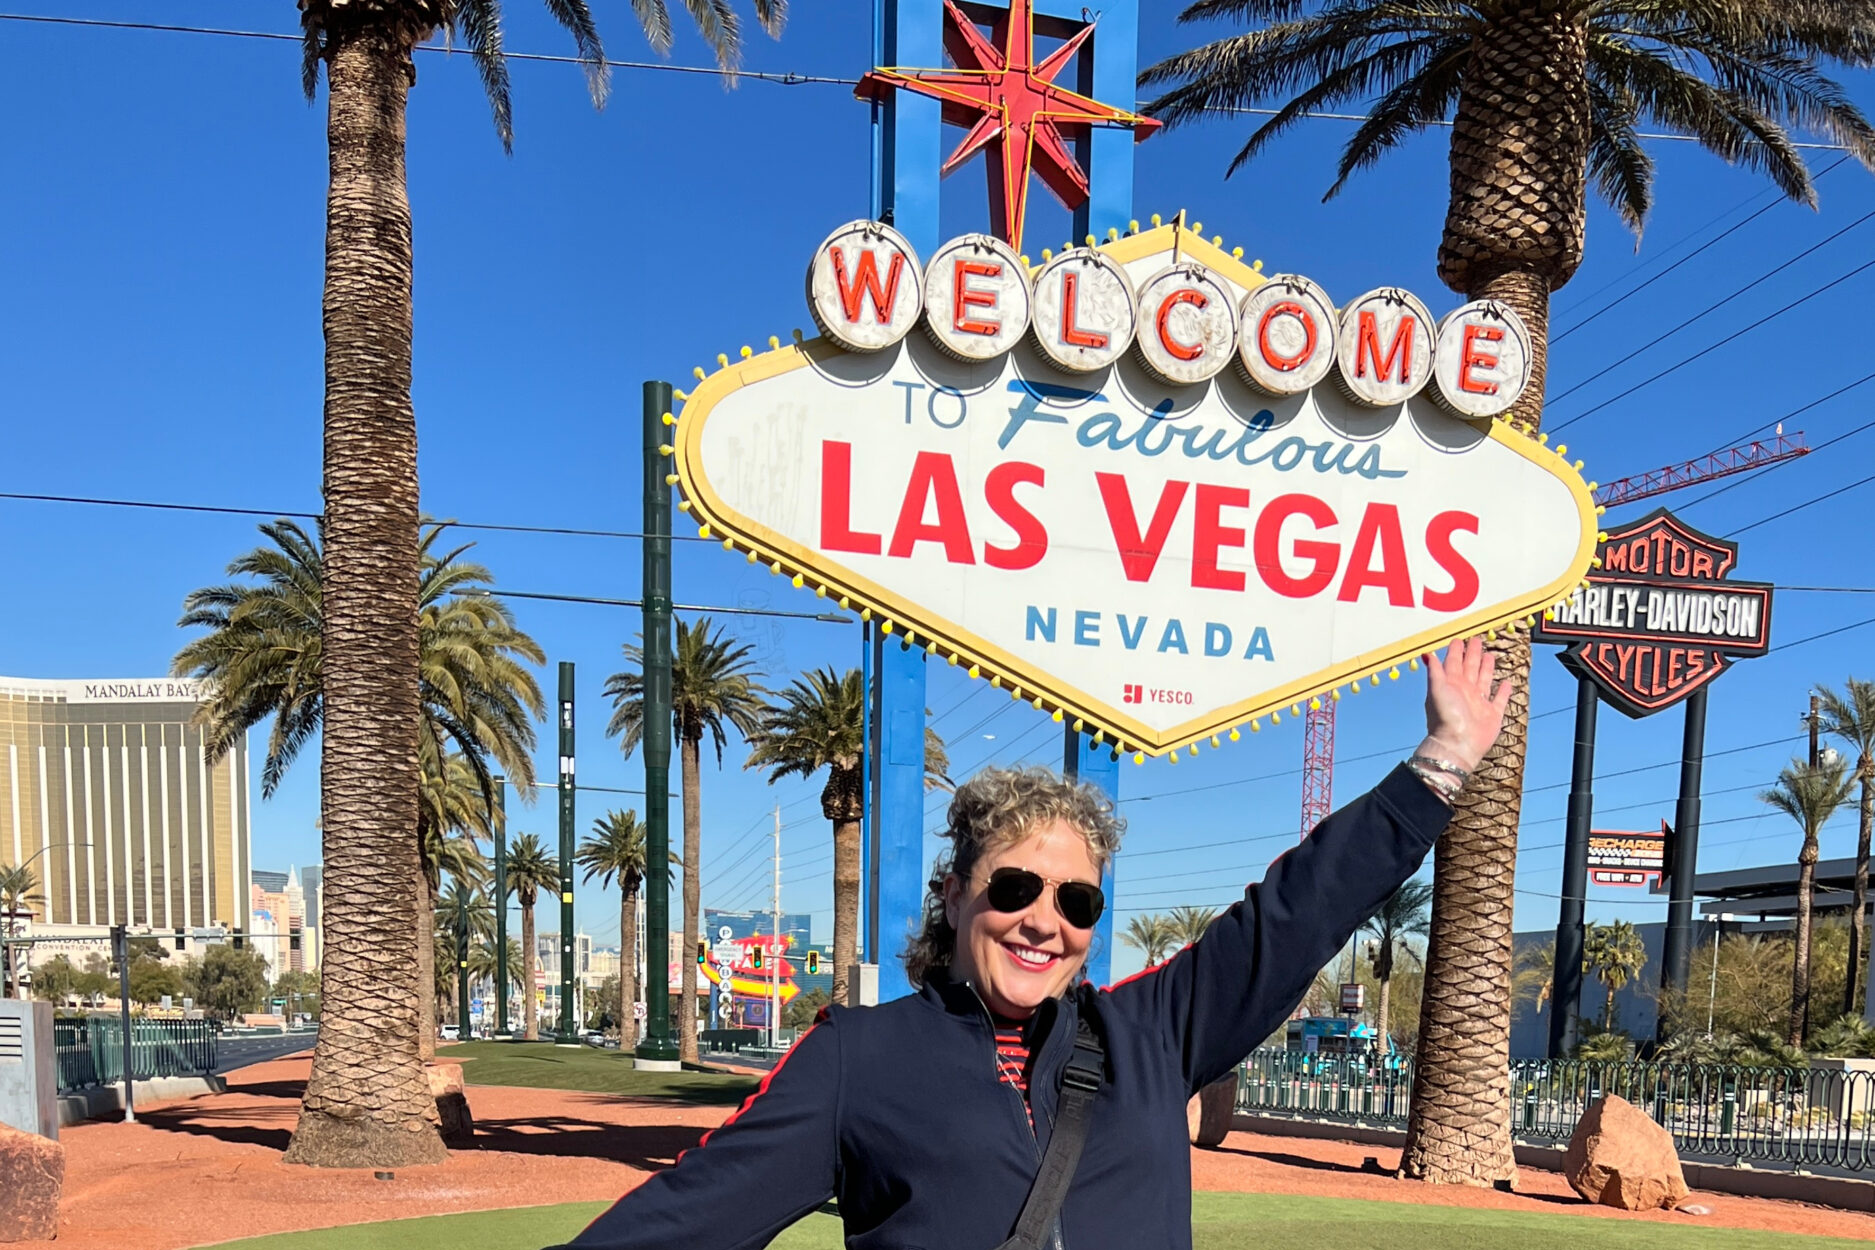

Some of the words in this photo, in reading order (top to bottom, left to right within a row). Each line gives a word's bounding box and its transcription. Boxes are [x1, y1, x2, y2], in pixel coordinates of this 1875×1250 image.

[829, 246, 1504, 396] WELCOME
[892, 380, 967, 429] TO
[999, 379, 1408, 479] Fabulous
[820, 439, 1048, 570] LAS
[1094, 471, 1480, 612] VEGAS
[1605, 528, 1714, 579] MOTOR
[1025, 605, 1275, 662] NEVADA
[1553, 585, 1760, 638] HARLEY-DAVIDSON
[85, 684, 162, 698] MANDALAY
[167, 683, 192, 697] BAY
[1598, 643, 1705, 696] CYCLES
[1149, 688, 1193, 705] YESCO
[36, 943, 91, 951] CONVENTION
